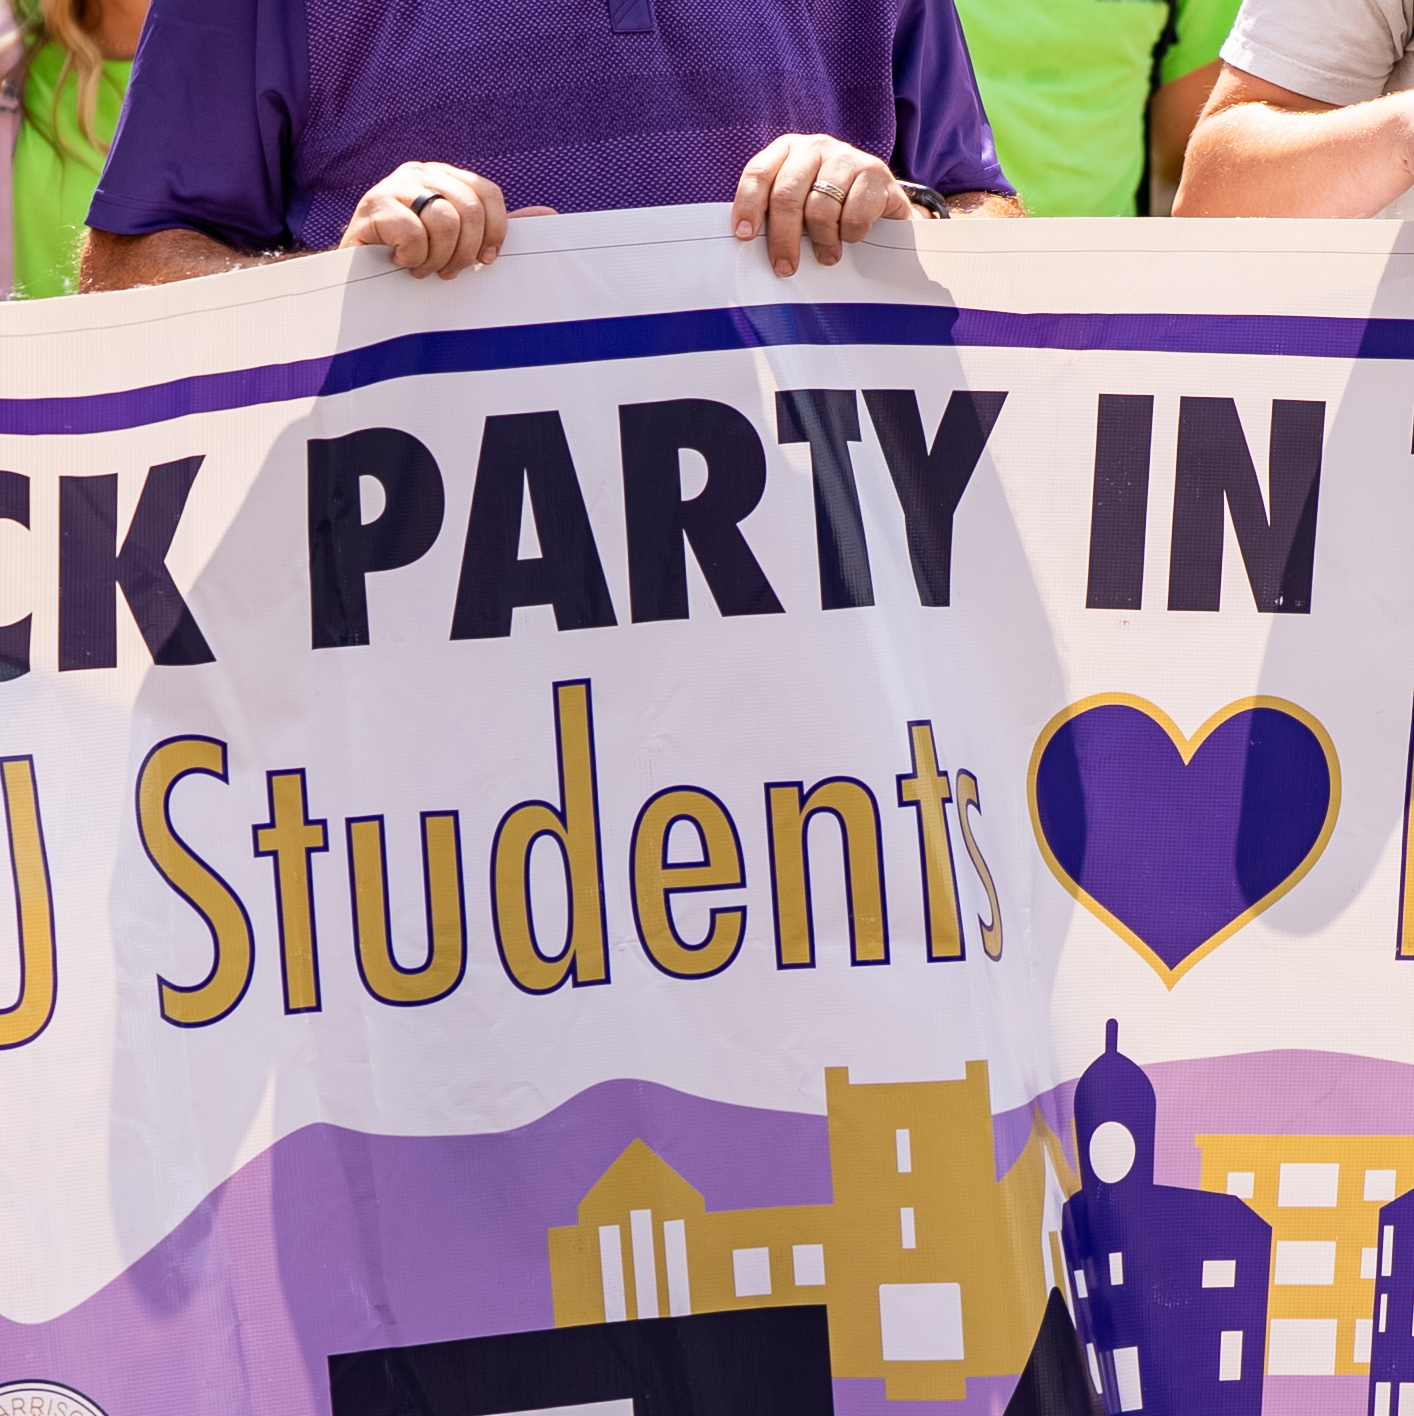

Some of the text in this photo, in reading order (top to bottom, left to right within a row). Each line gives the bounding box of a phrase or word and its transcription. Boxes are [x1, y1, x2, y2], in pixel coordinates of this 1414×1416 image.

[307, 388, 1009, 650] PARTY
[1085, 393, 1327, 615] IN
[134, 677, 1003, 1029] Students
